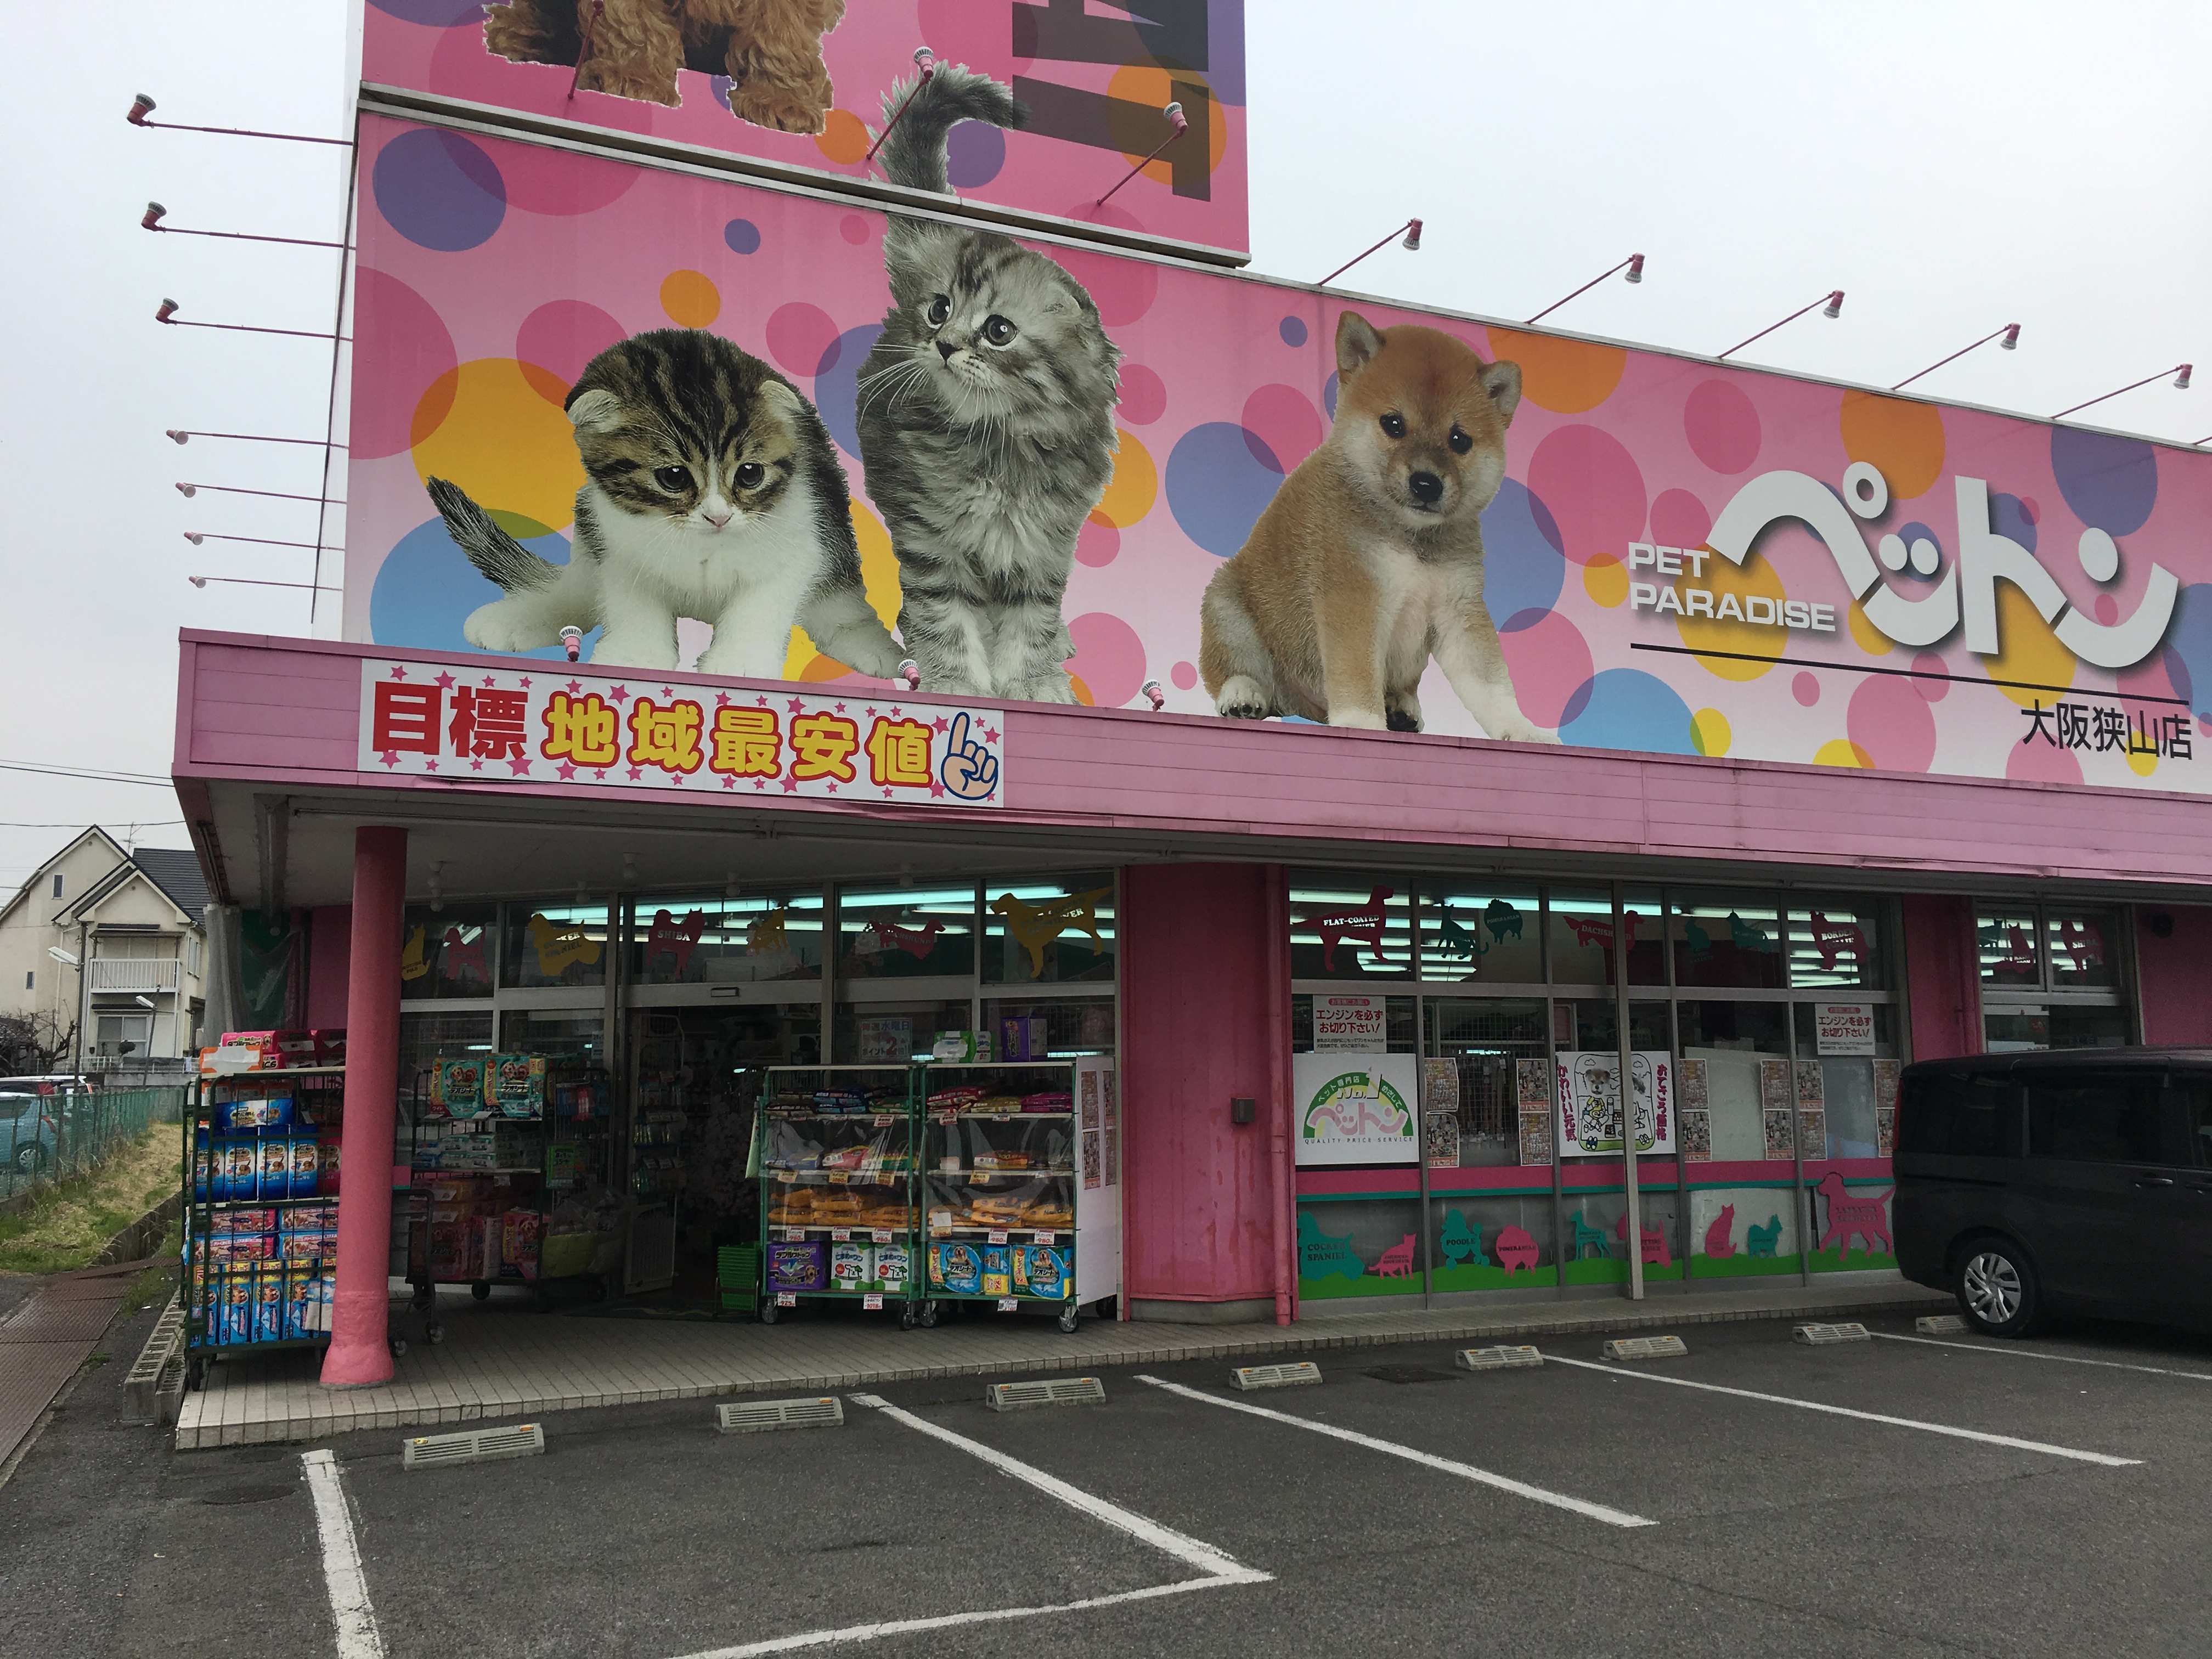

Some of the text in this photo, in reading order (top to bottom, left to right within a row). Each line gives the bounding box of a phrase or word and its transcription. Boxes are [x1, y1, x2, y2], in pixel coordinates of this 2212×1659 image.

[1628, 541, 1709, 578] PET
[1705, 461, 2178, 667] ペットン
[1629, 582, 1836, 632] PARADISE
[373, 681, 934, 788] 目標地域最安値
[2021, 698, 2193, 760] 大阪狭山店
[1323, 915, 1380, 926] FLAT-COATED
[657, 930, 691, 941] SHIBA
[1582, 925, 1632, 940] DACHSHD
[1821, 929, 1855, 940] BORDER
[1316, 1009, 1384, 1021] エンジンを必ず
[1818, 1016, 1871, 1026] エンジンを必ず
[1307, 1242, 1346, 1251] COCKER
[1446, 1238, 1476, 1246] POODLE
[1307, 1252, 1346, 1262] SPANIEL
